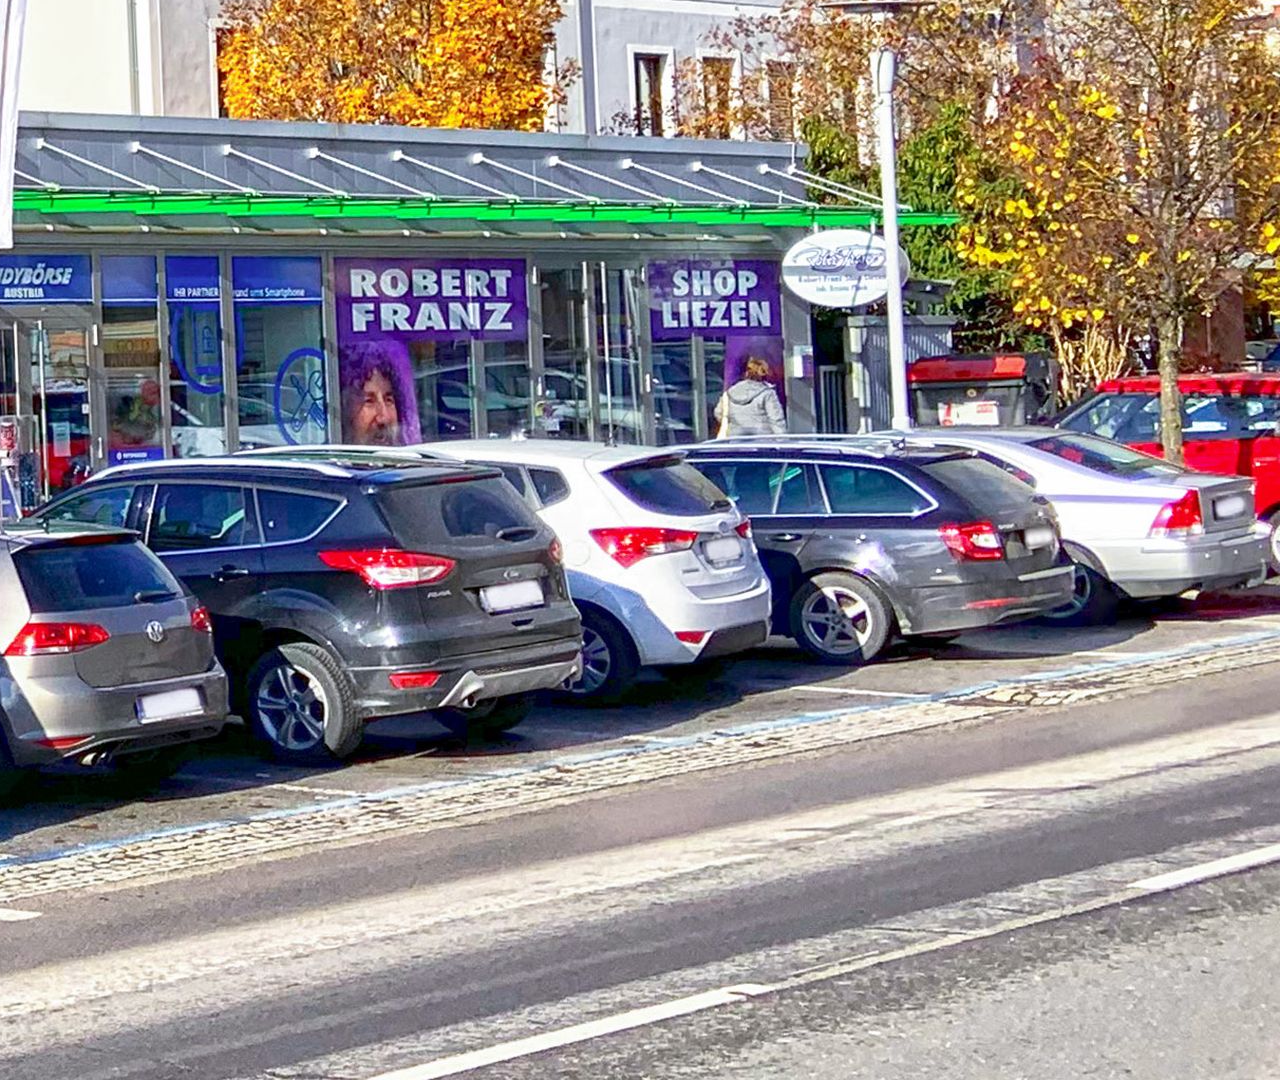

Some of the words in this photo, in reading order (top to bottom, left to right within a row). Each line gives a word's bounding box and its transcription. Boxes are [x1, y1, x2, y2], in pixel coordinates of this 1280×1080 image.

[4, 287, 44, 299] AUSTRIA
[173, 287, 186, 298] IHR
[187, 287, 218, 298] PARTNER
[265, 286, 306, 299] Smartphone
[350, 269, 513, 297] ROBERT
[672, 269, 758, 297] SHOP
[352, 302, 513, 332] FRANZ
[662, 301, 771, 328] LIEZEN
